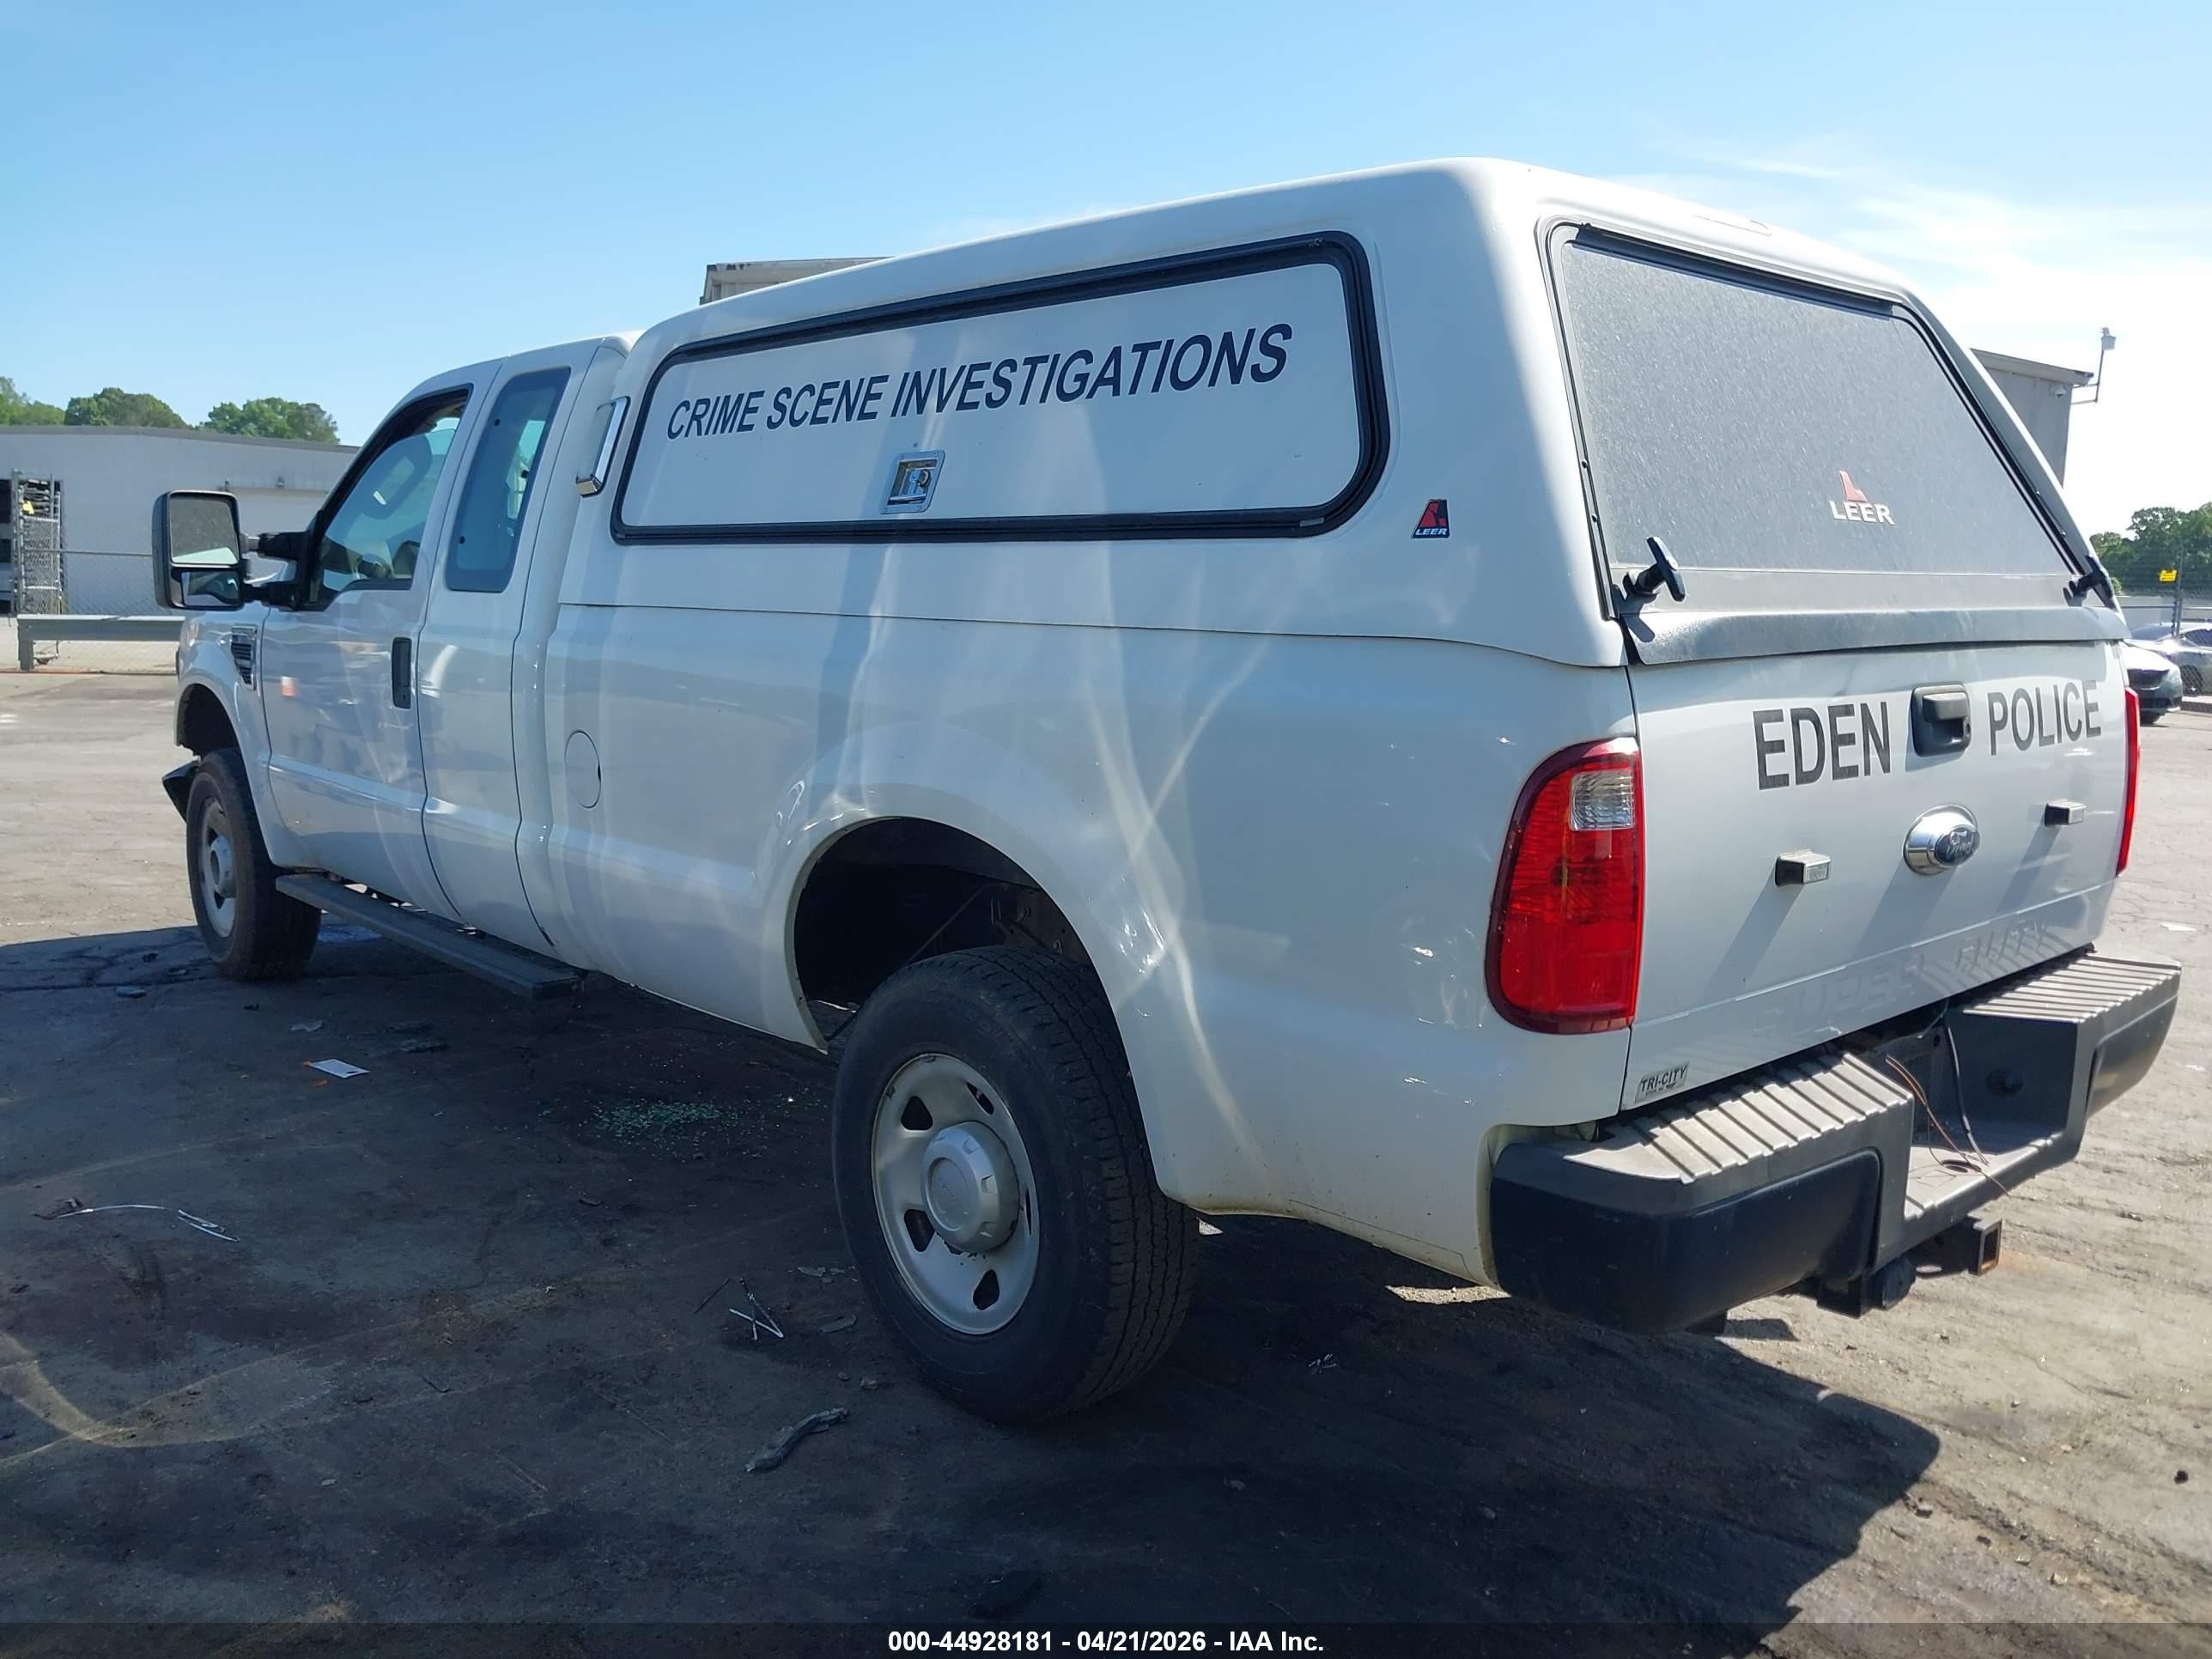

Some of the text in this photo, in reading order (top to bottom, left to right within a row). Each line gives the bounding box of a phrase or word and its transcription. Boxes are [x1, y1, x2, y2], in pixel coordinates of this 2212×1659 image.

[667, 323, 1292, 440] CRIME SCENE INVESTIGATIONS
[1828, 500, 1895, 525] LEER
[1753, 680, 2102, 790] EDEN POLICE
[1641, 1065, 1688, 1092] TRI-CITY
